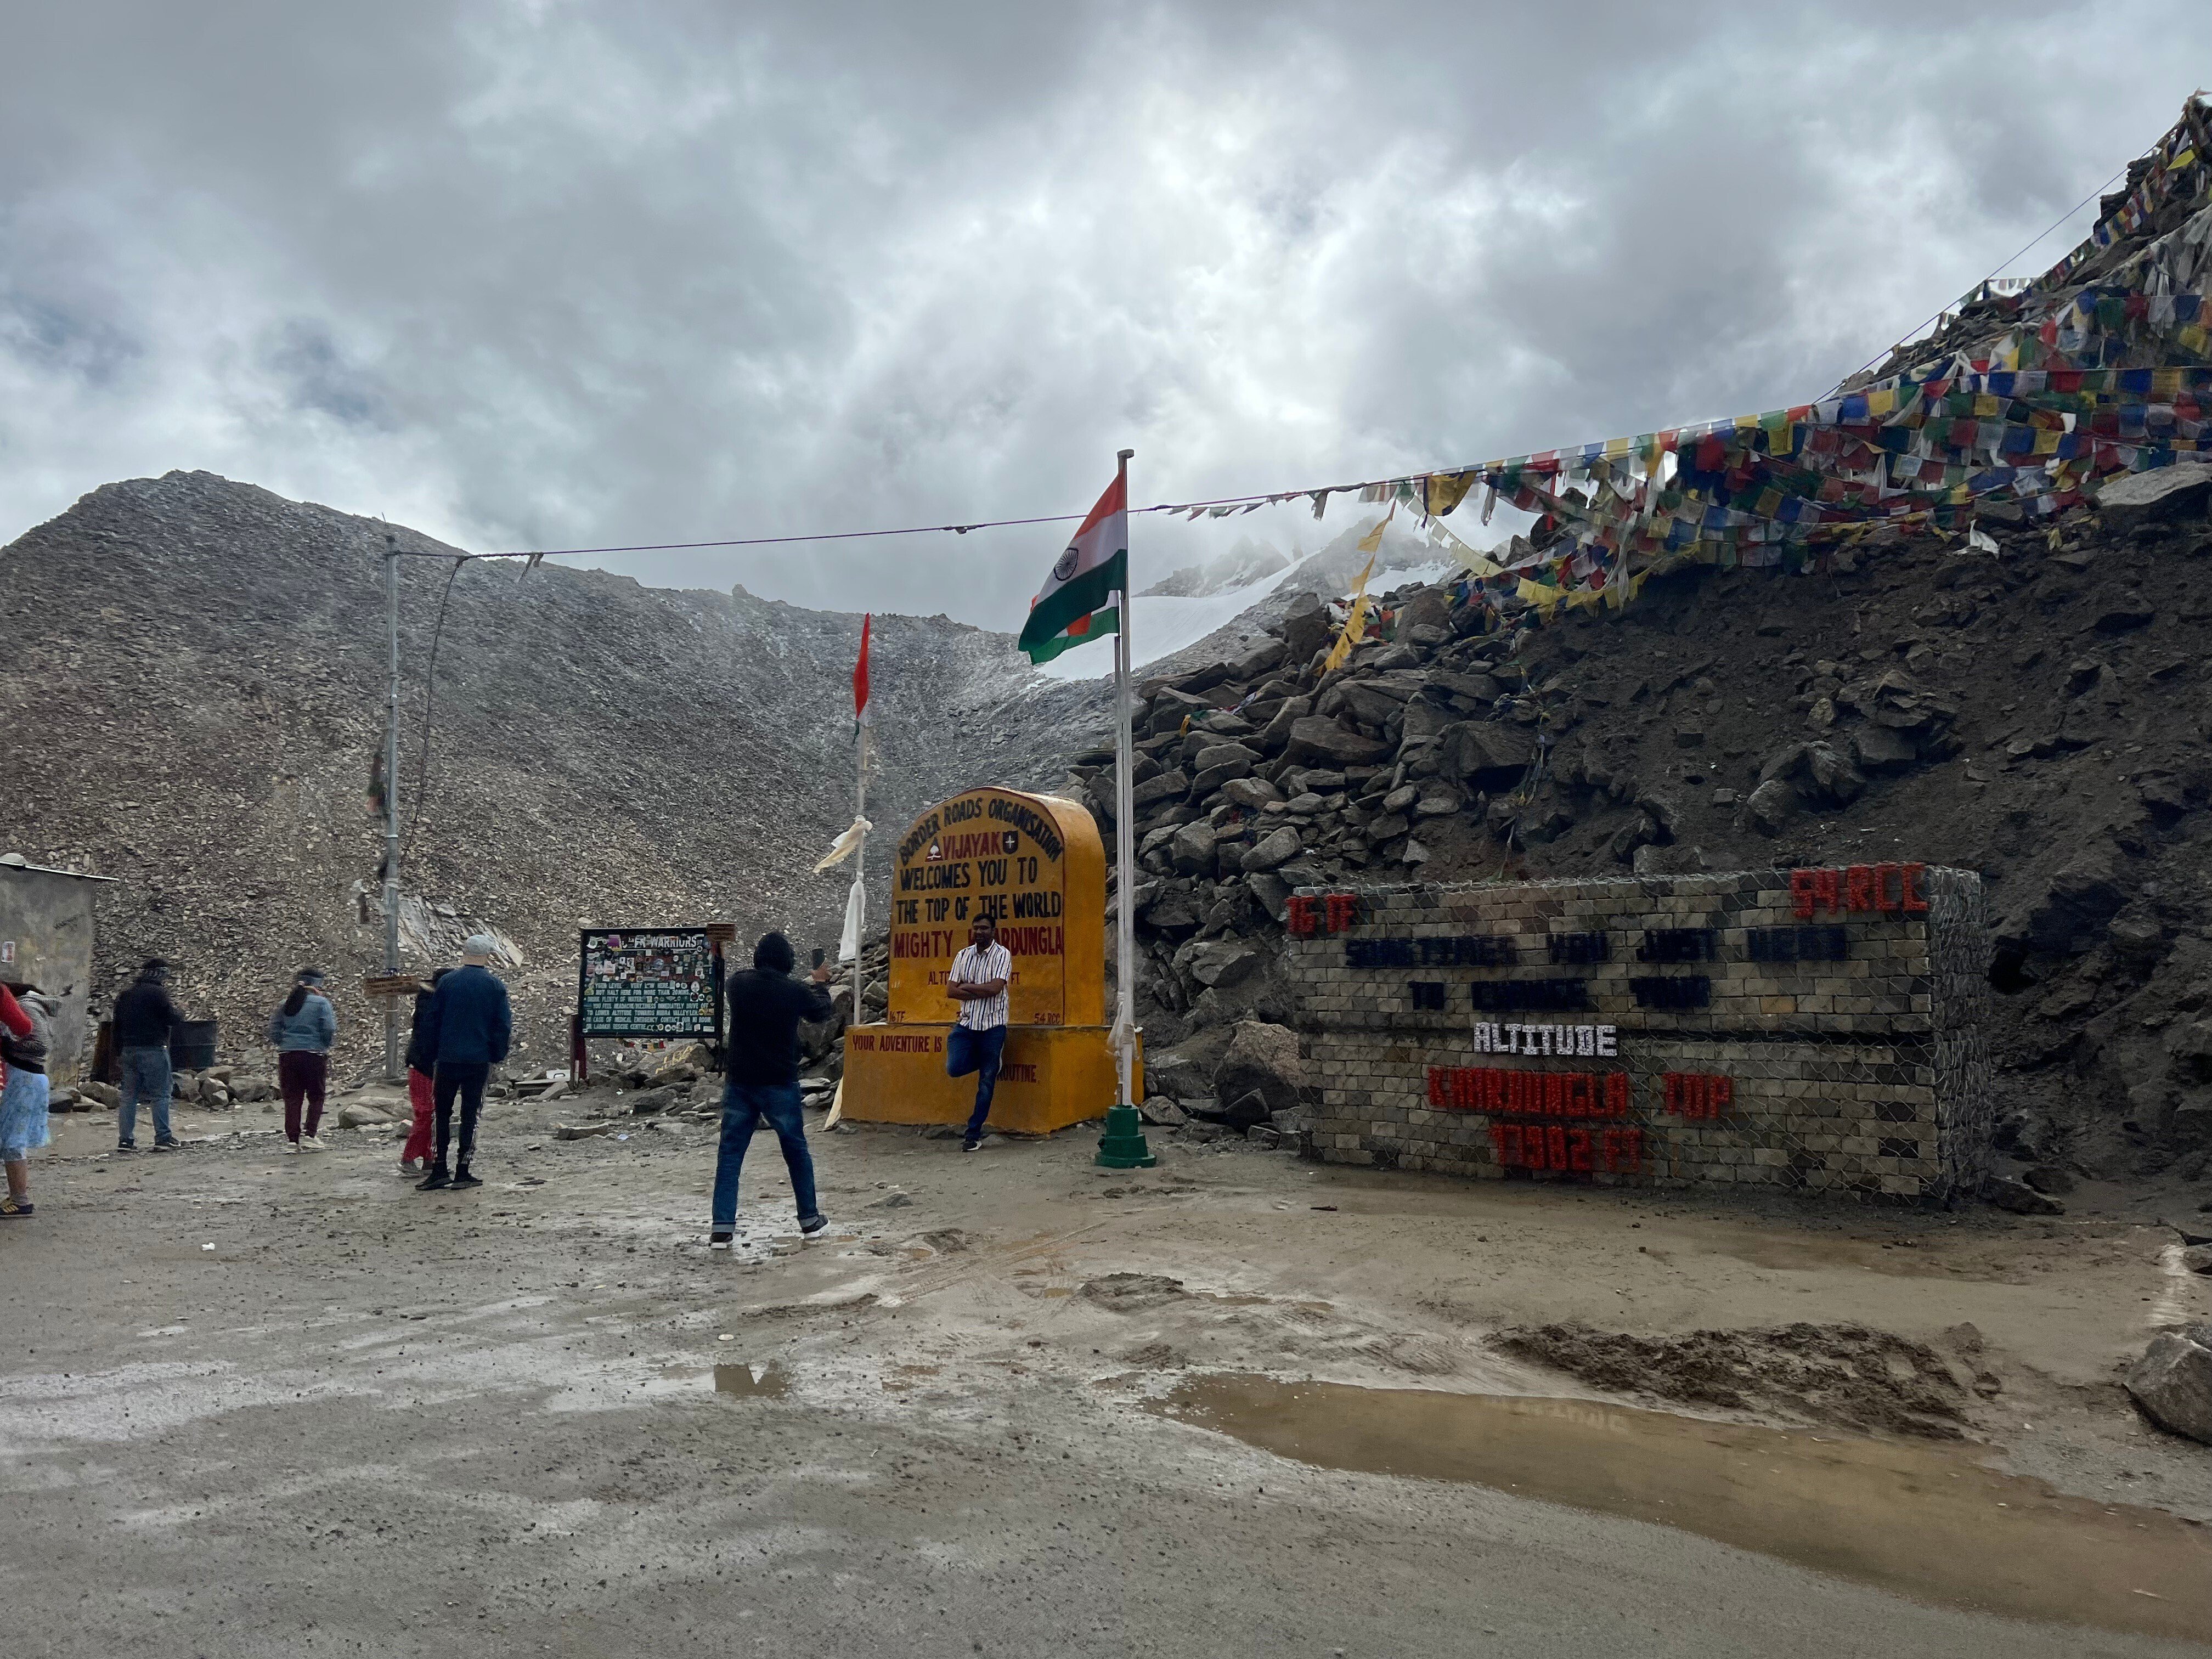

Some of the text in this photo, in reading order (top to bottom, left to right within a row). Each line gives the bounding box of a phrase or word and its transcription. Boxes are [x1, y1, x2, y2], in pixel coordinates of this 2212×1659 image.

[899, 797, 1063, 866] BORDER ROADS ORGANISATION
[943, 831, 1002, 861] VIJAYAK
[900, 856, 1038, 891] WELCOMES YOU TO
[1847, 862, 1929, 912] RCC
[896, 891, 1062, 924] THE TOP OF THE WORLD
[894, 926, 1063, 958] MIGHTY RDUNGLA
[853, 1035, 942, 1053] YOUR ADVENTURE IS
[1474, 1022, 1617, 1056] ALTITUDE
